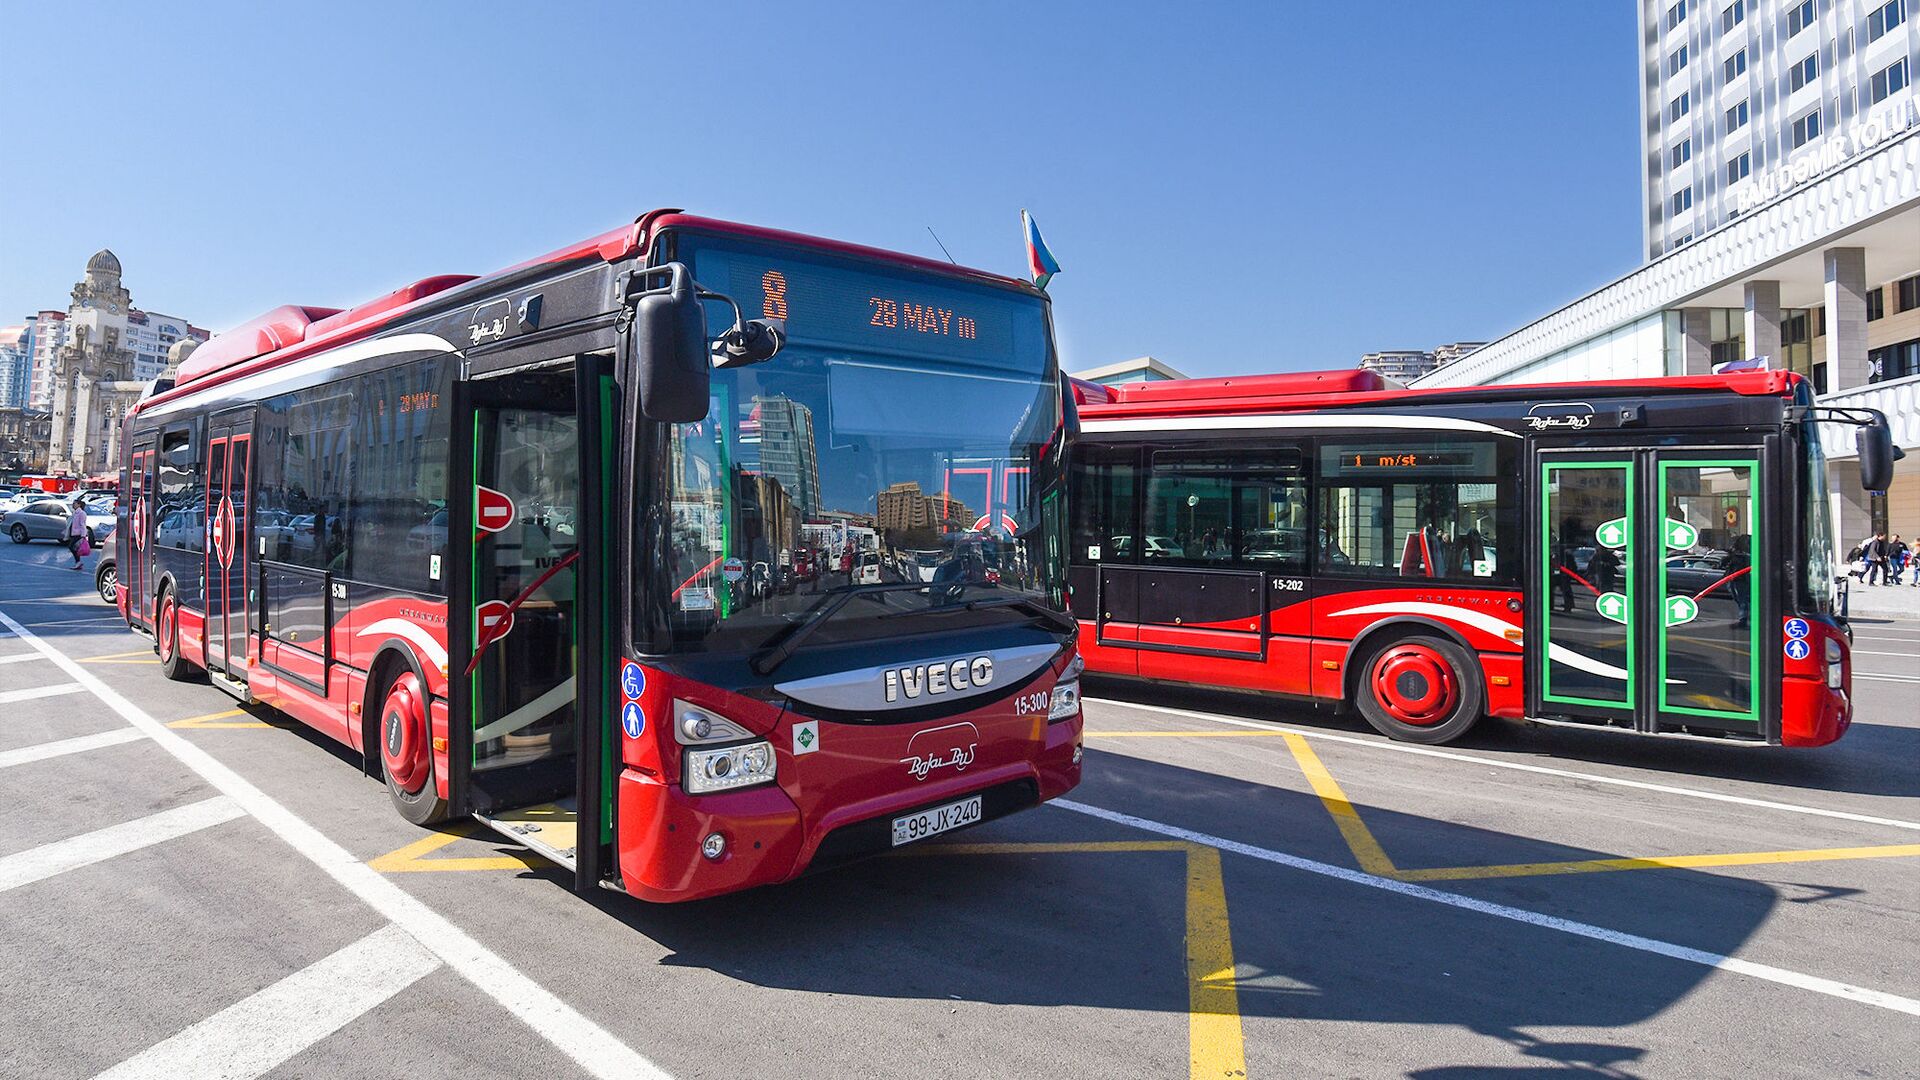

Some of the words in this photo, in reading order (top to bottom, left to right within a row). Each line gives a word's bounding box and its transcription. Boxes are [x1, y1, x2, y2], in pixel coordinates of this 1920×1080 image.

[1737, 172, 1775, 213] BAKI
[1849, 100, 1912, 154] YOLU
[762, 270, 787, 321] 8
[869, 297, 897, 328] 28
[904, 303, 951, 336] MAY
[957, 316, 976, 339] m
[1272, 578, 1304, 591] 15-202
[885, 656, 993, 702] IVECO
[1014, 691, 1048, 717] 15-300
[901, 752, 943, 779] Baku
[909, 801, 979, 838] 99-JX-240
